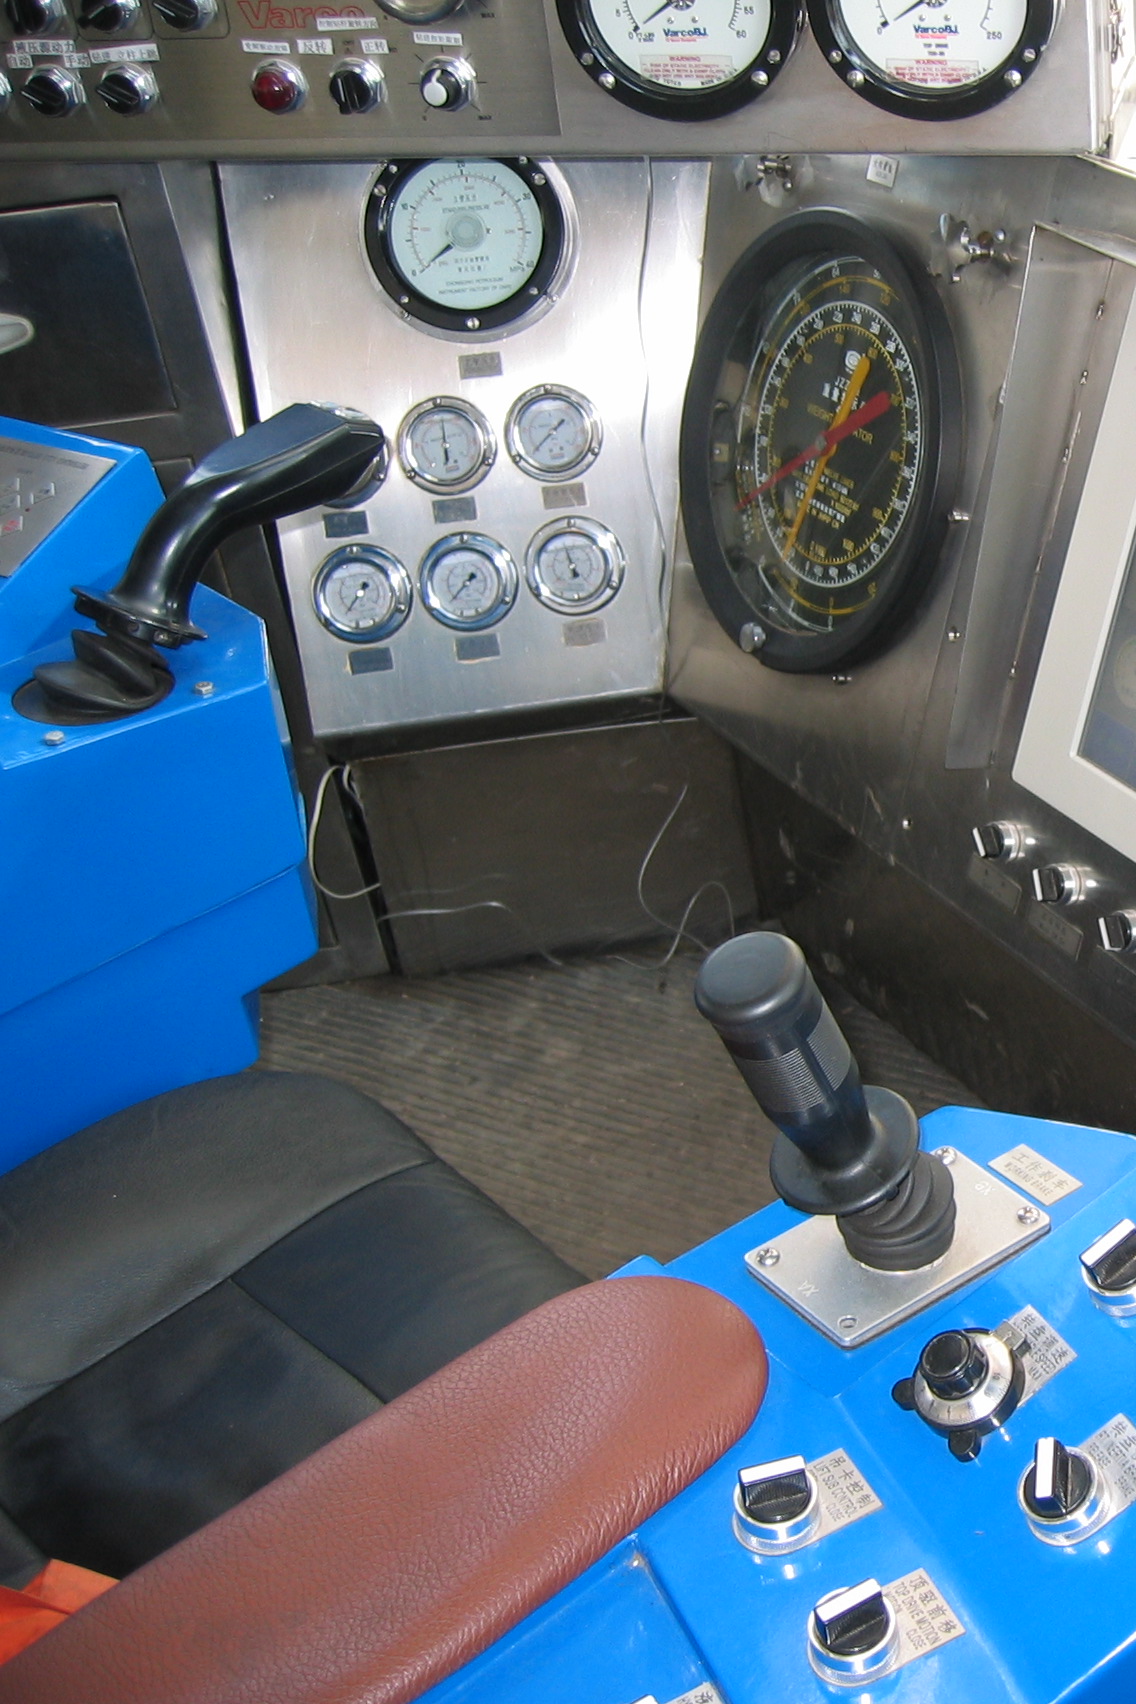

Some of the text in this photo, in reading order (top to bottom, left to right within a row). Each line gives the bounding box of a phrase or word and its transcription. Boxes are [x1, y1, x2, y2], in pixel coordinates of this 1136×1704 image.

[302, 40, 329, 54] 反转
[363, 40, 385, 53] 正转
[1004, 1162, 1054, 1196] WORKING BRAKE
[1012, 1152, 1070, 1191] 工作刹车
[1035, 1353, 1057, 1374] SPEED
[813, 1461, 831, 1477] LIFT
[822, 1474, 840, 1490] SUB
[831, 1487, 858, 1518] CONTROL
[828, 1455, 876, 1509] 吊卡控制
[825, 1502, 845, 1522] CLOSE
[893, 1582, 942, 1645] TOP DRIVE MOTION
[909, 1575, 957, 1636] 顶驱前移
[906, 1628, 927, 1650] CLOSE
